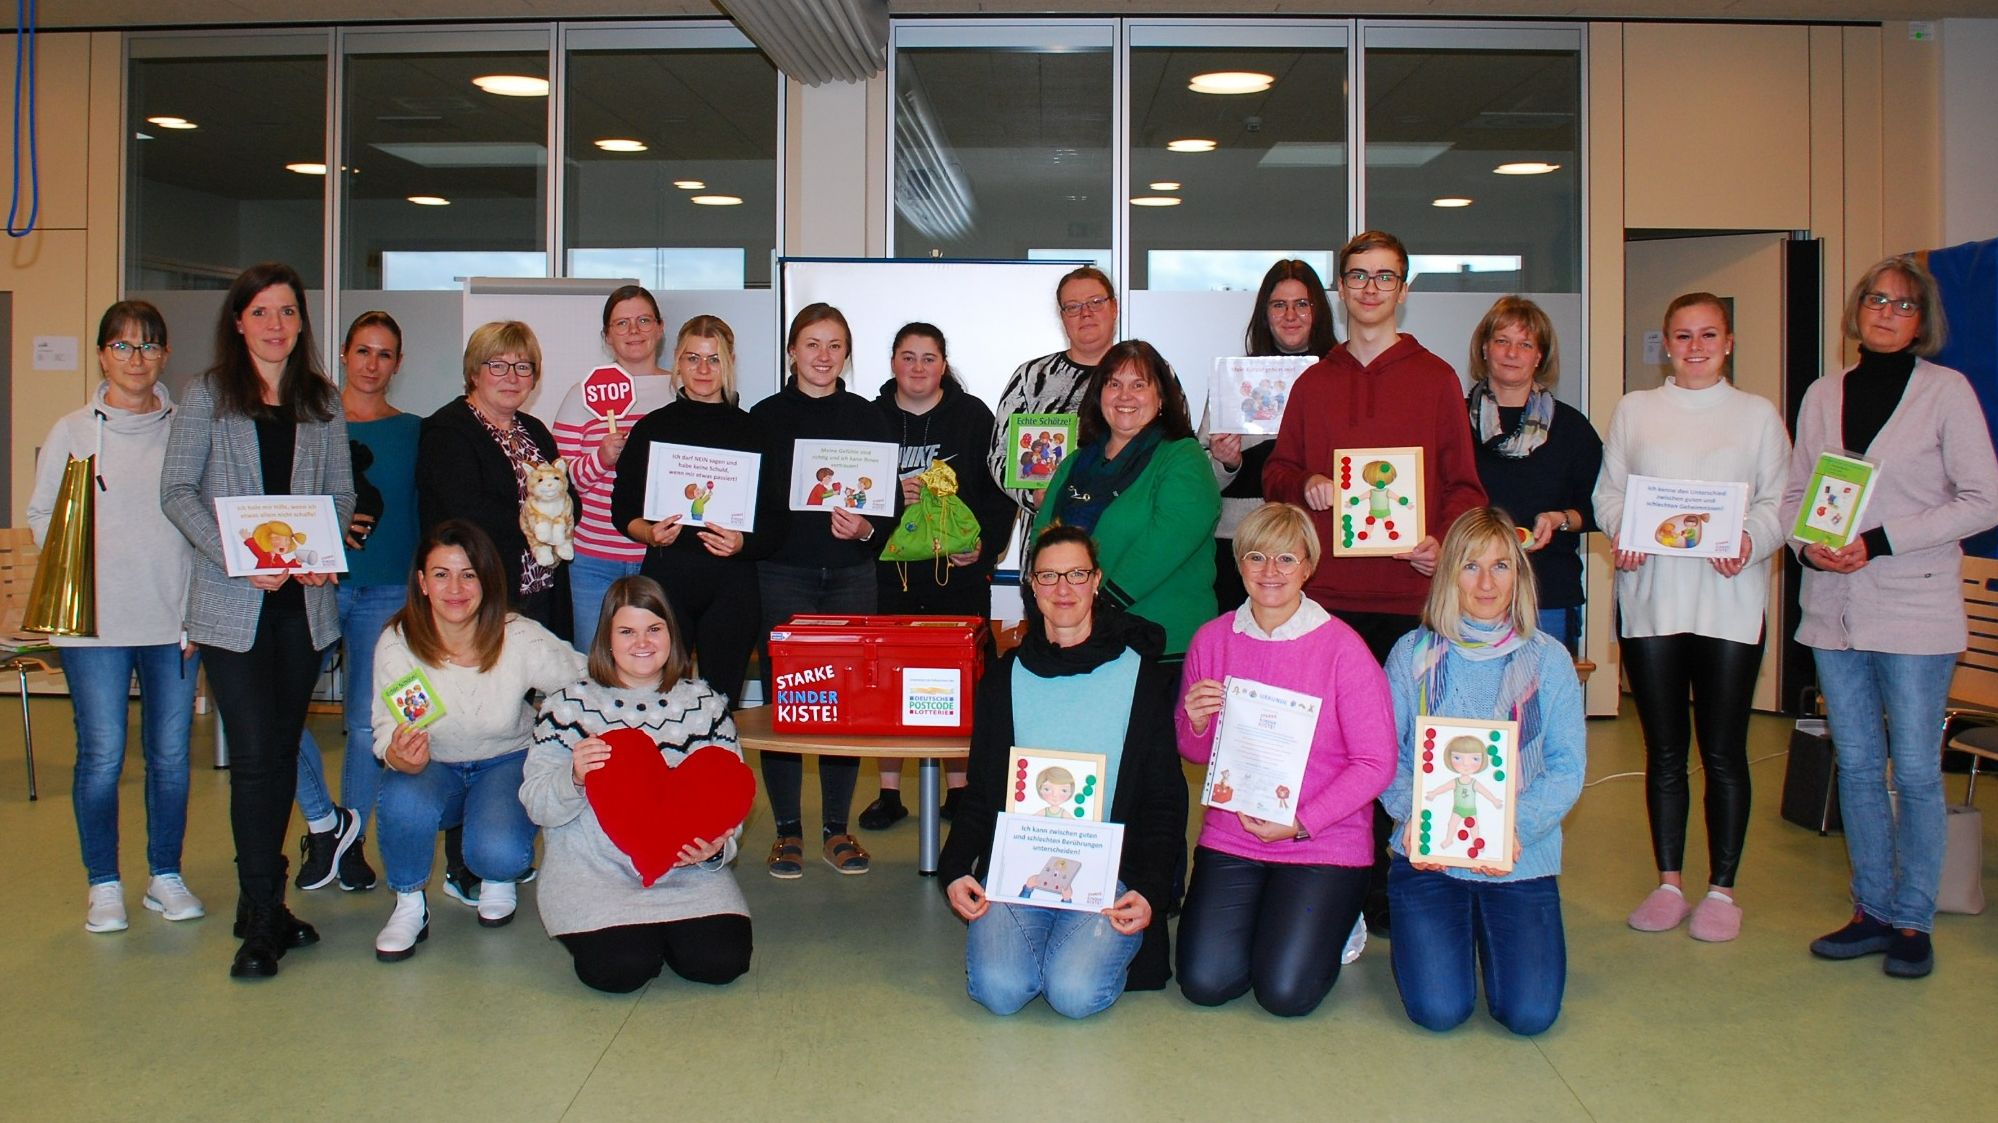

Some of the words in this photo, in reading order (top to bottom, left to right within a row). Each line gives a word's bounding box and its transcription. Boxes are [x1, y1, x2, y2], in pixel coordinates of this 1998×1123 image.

[587, 382, 629, 402] STOP
[1040, 417, 1071, 425] Schätze!
[899, 444, 940, 468] NIKE
[776, 664, 835, 690] STARKE
[777, 690, 838, 705] KINDER
[909, 702, 954, 710] POSTCODE
[777, 705, 838, 722] KISTE!
[1032, 826, 1048, 834] kann
[1049, 828, 1078, 837] zwischen
[1027, 835, 1060, 844] schlechten
[1062, 838, 1103, 848] Berührungen
[1033, 845, 1080, 855] unterscheiden!
